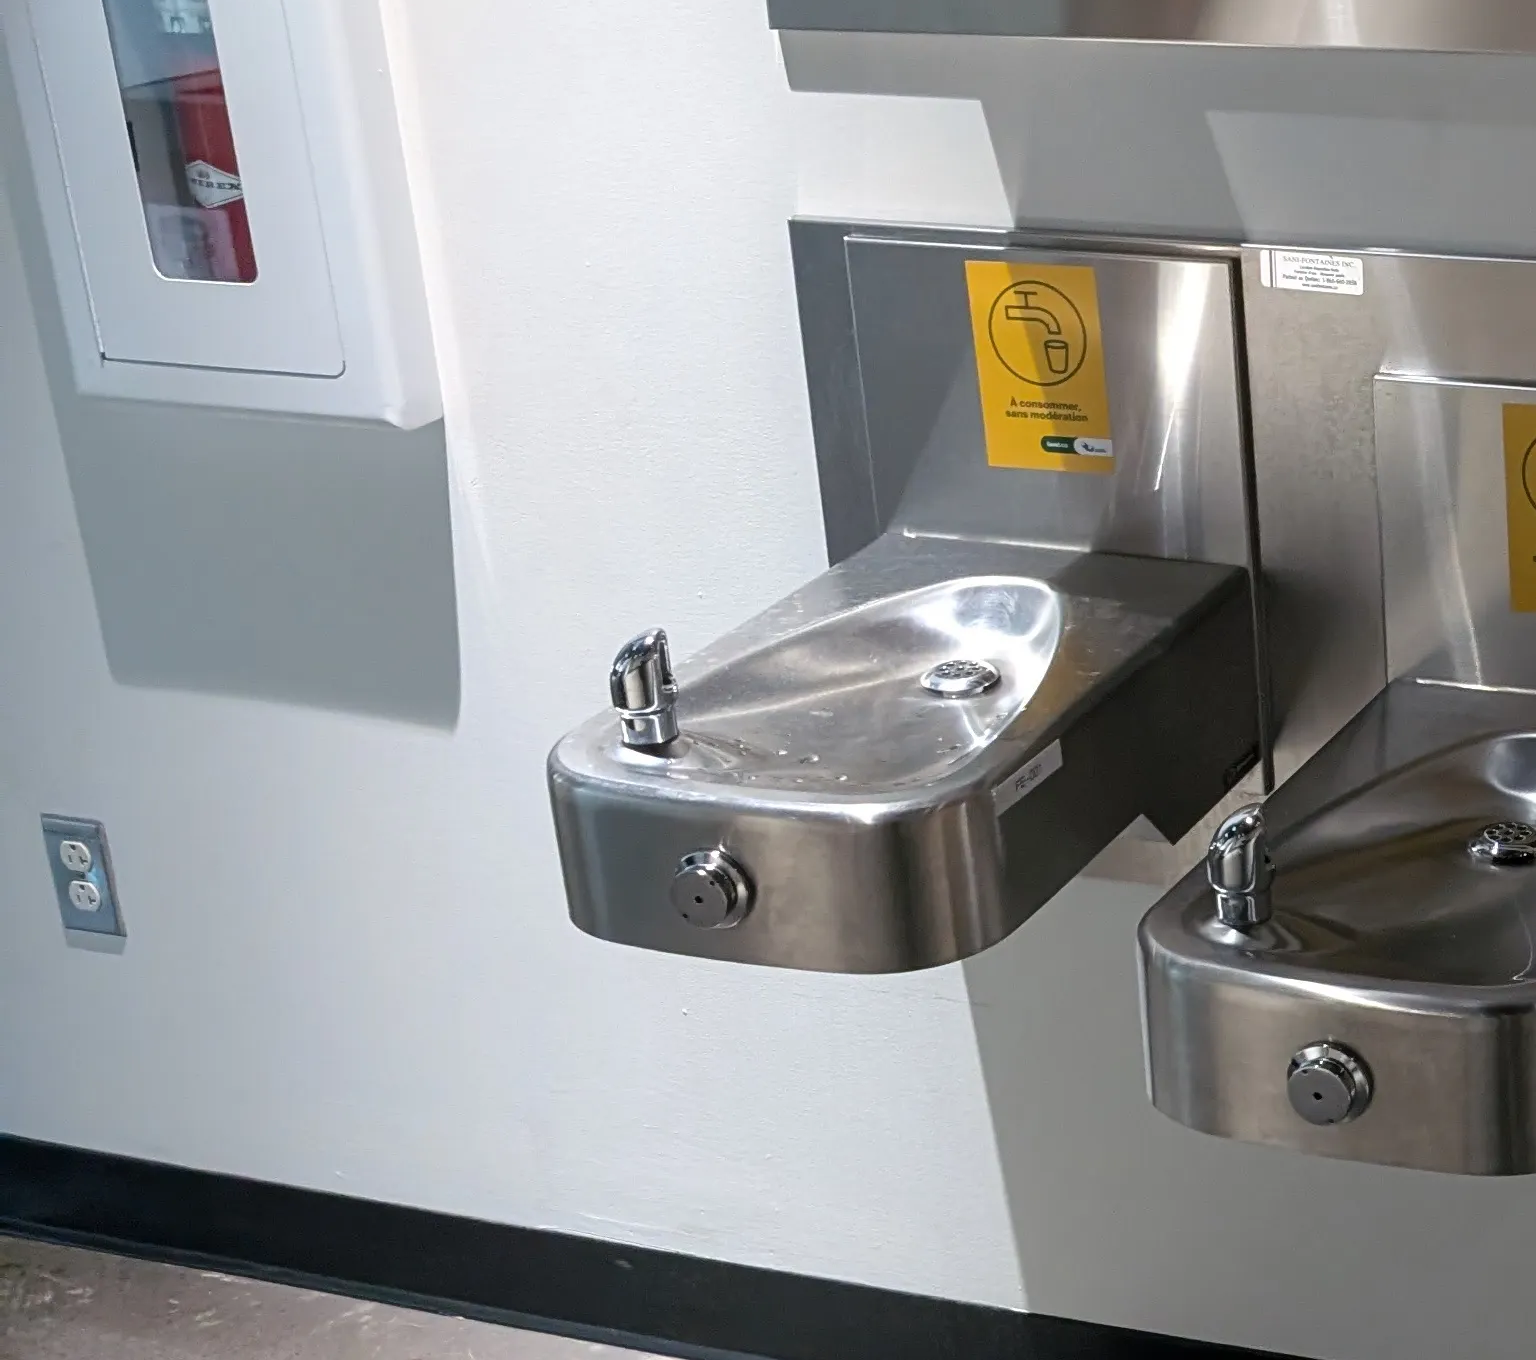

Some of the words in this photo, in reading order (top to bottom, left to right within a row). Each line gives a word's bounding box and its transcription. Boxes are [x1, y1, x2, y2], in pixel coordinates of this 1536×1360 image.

[1019, 400, 1082, 412] consommer,
[1005, 409, 1029, 419] sans
[1030, 411, 1089, 422] modération
